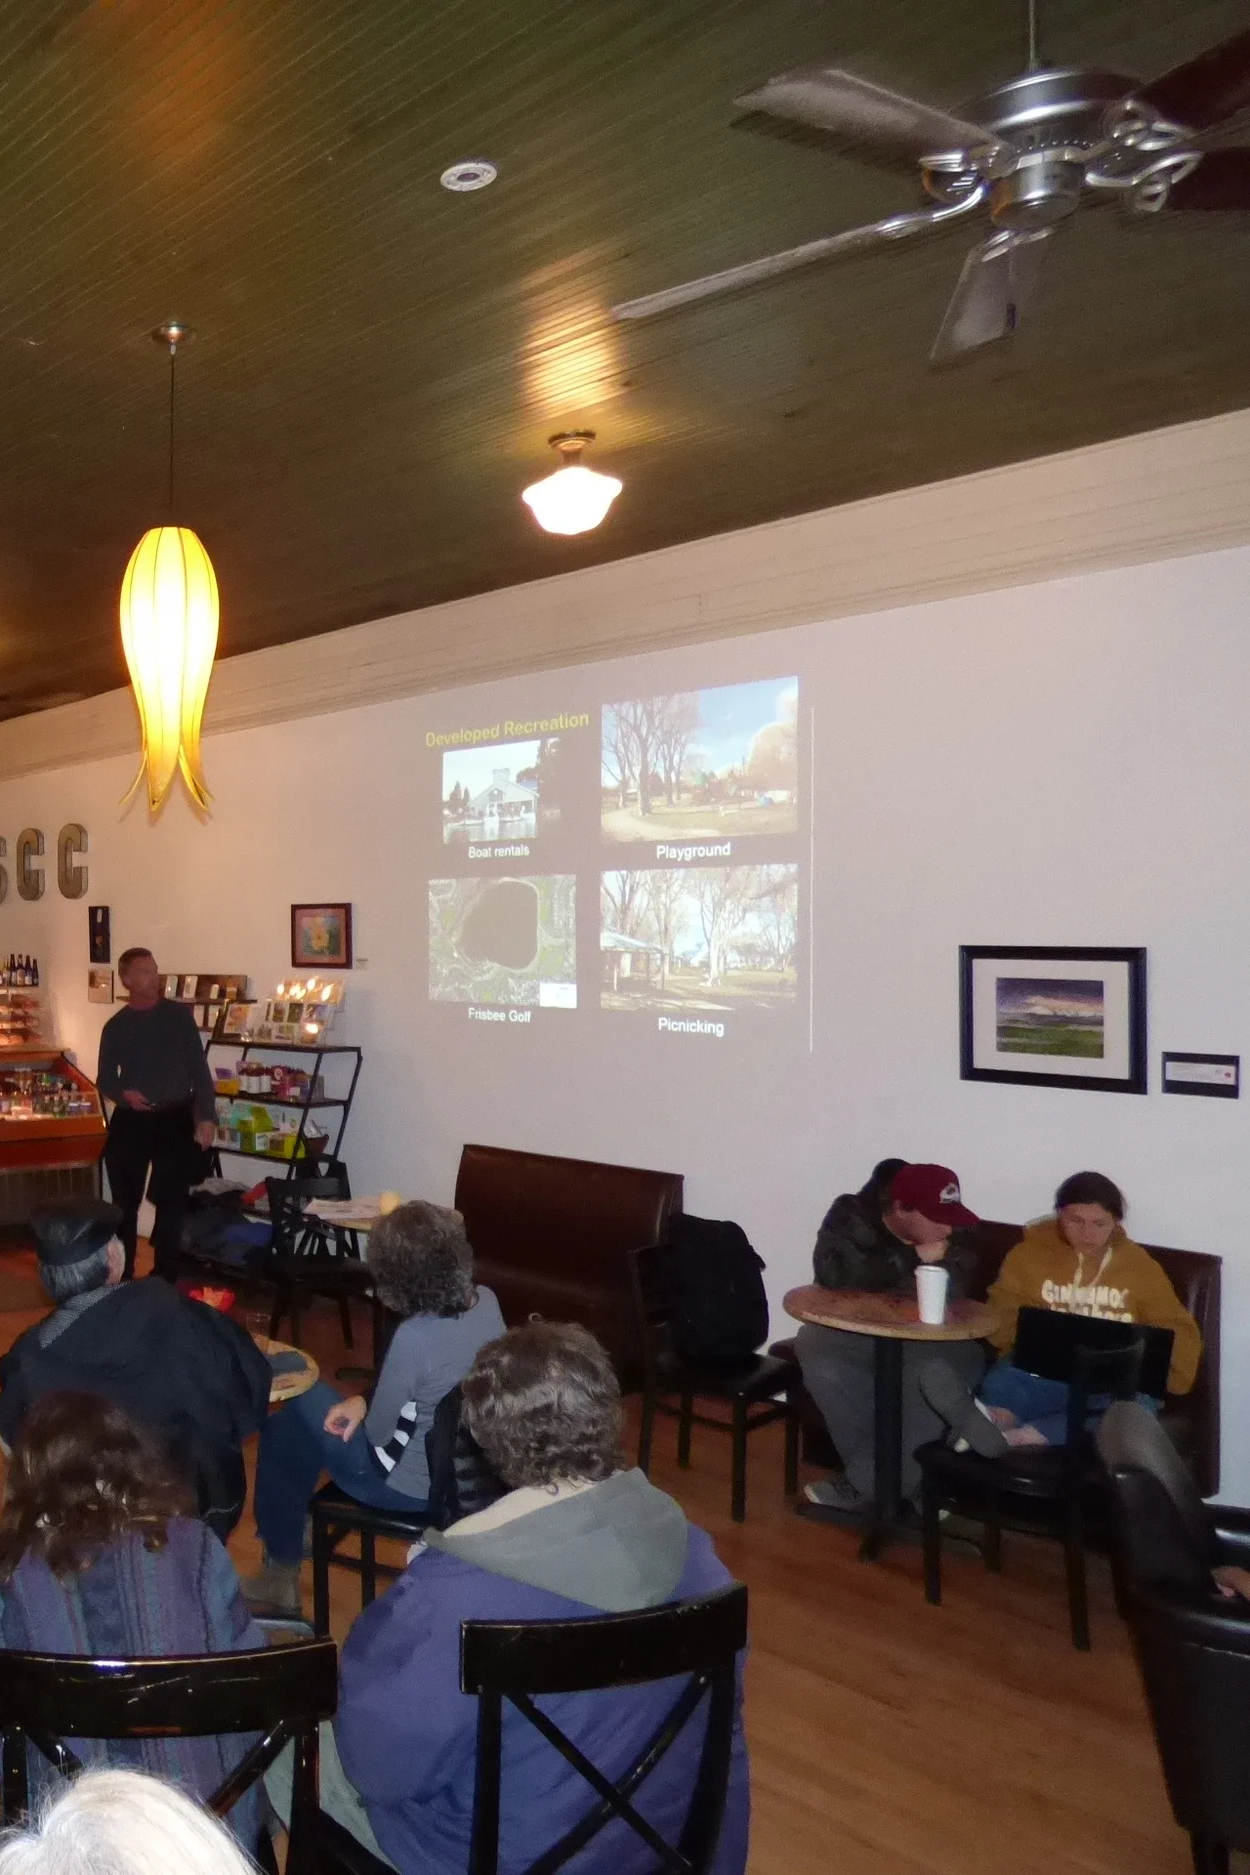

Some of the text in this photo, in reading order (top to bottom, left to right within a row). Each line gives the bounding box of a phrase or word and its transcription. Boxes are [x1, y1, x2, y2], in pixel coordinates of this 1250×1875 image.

[426, 712, 589, 747] Developed Recreation
[468, 844, 530, 859] Boat rentals
[656, 842, 731, 861] Playground
[468, 1007, 531, 1023] Frisbee Golf
[658, 1017, 724, 1037] Picnicking
